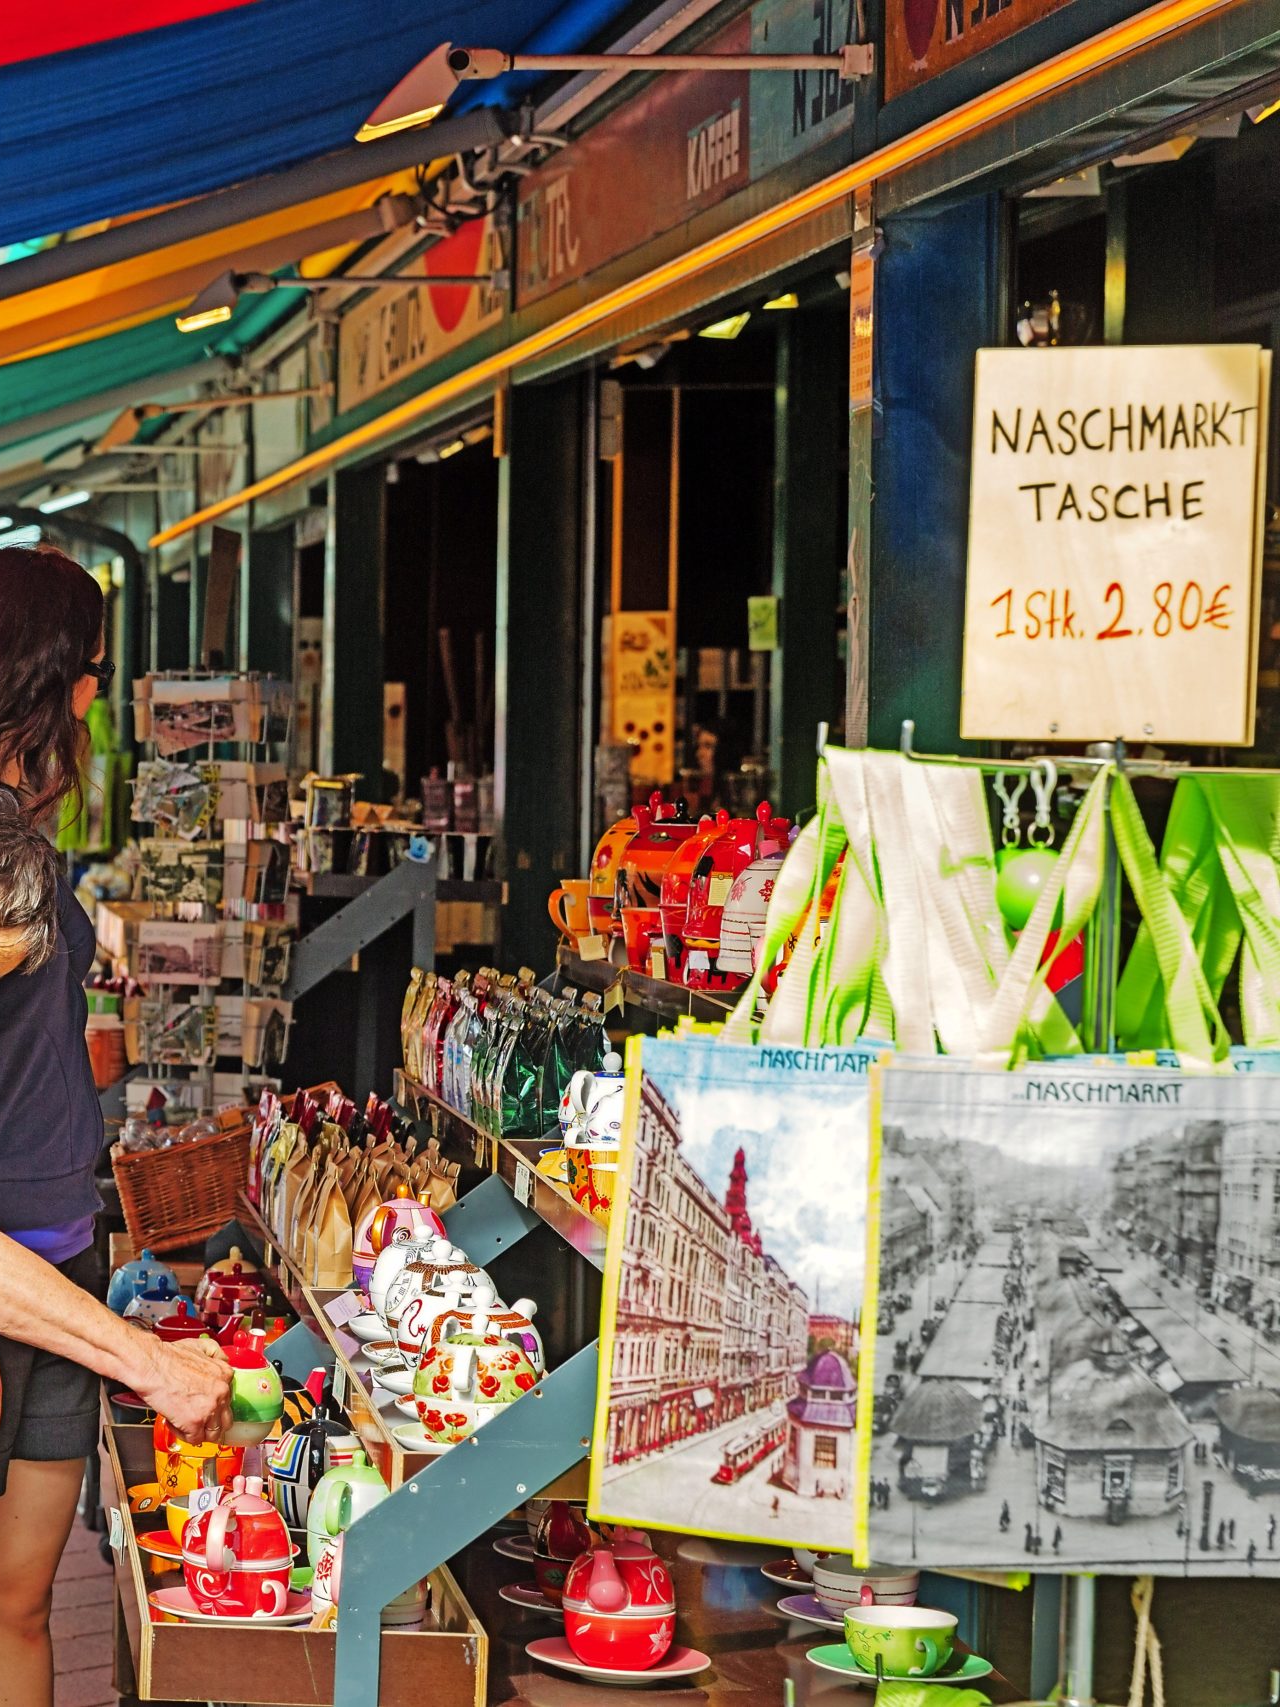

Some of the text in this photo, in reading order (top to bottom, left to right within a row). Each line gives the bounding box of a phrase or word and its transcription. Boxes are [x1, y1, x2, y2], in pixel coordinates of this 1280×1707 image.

[686, 102, 740, 200] KAFFEE
[991, 401, 1258, 455] NASCHMARKT
[1018, 480, 1205, 523] TASCHE
[759, 1049, 878, 1074] NASCHMAR
[1026, 1082, 1183, 1103] NASCHMARKT
